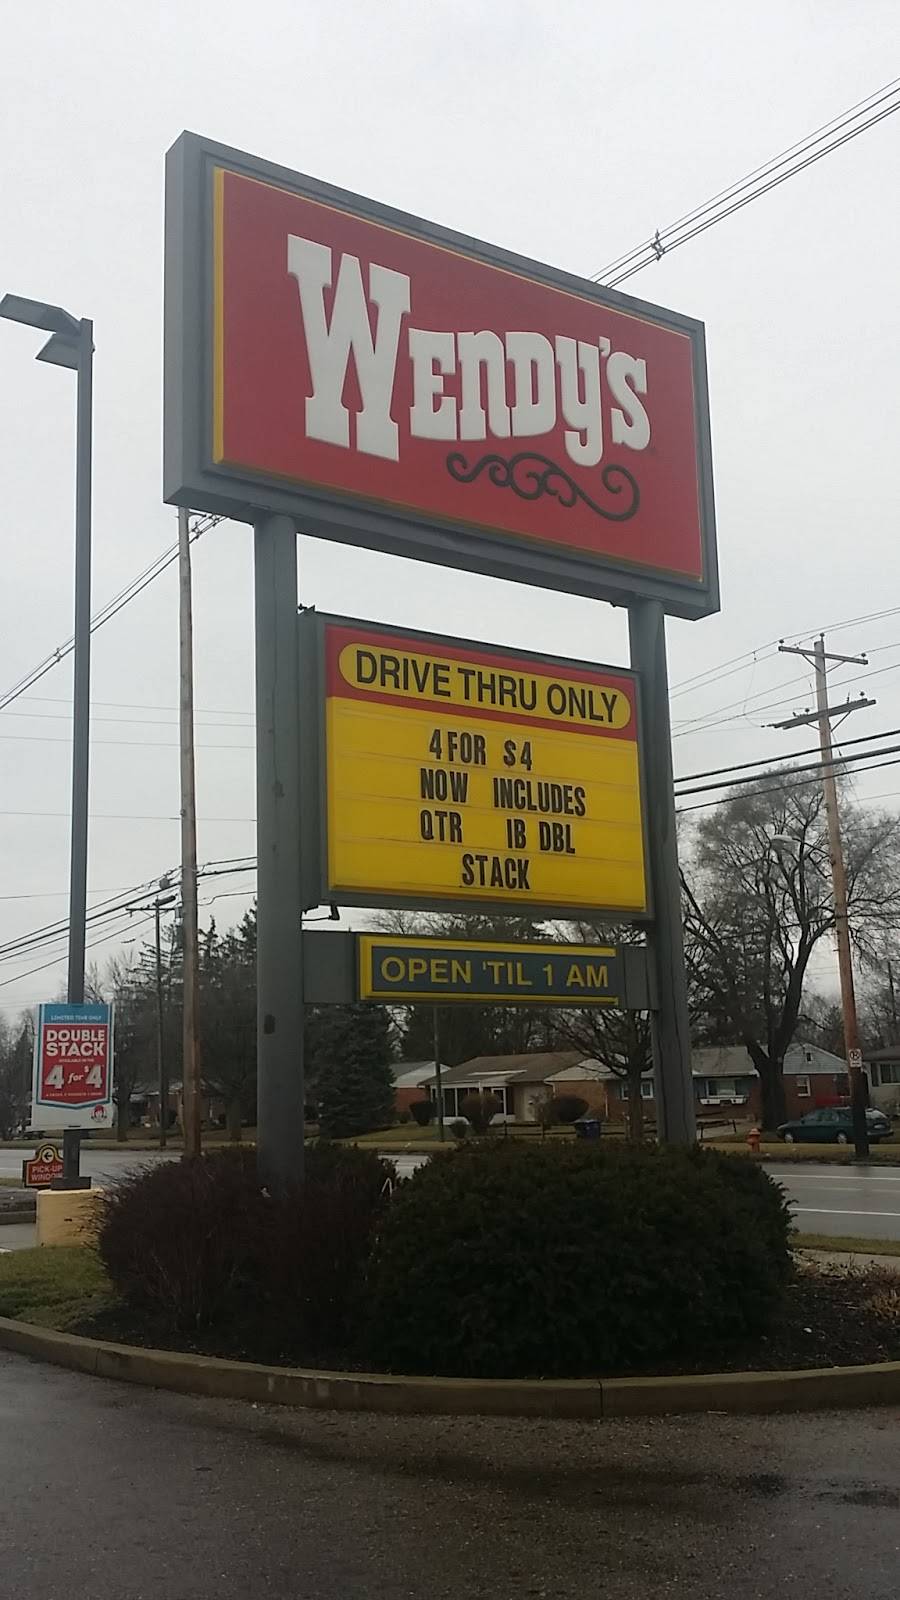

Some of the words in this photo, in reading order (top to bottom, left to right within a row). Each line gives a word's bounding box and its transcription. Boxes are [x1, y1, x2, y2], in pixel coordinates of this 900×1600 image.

[356, 650, 451, 697] DRIVE
[457, 668, 537, 710] THRU
[547, 683, 617, 722] ONLY
[429, 729, 442, 760] 4
[447, 731, 486, 765] FOR
[420, 768, 468, 802] NOW
[493, 777, 586, 816] INCLUDES
[420, 809, 463, 843] QTR
[539, 821, 576, 854] DBL
[462, 853, 530, 889] STACK
[381, 956, 472, 984] OPEN
[483, 961, 533, 985] 'TIL
[543, 967, 552, 986] 1
[566, 964, 608, 988] AM
[46, 1029, 105, 1042] DOUBLE
[46, 1042, 105, 1057] STACK
[44, 1064, 65, 1090] 4
[68, 1072, 84, 1084] for
[32, 1165, 63, 1173] PICK-UP
